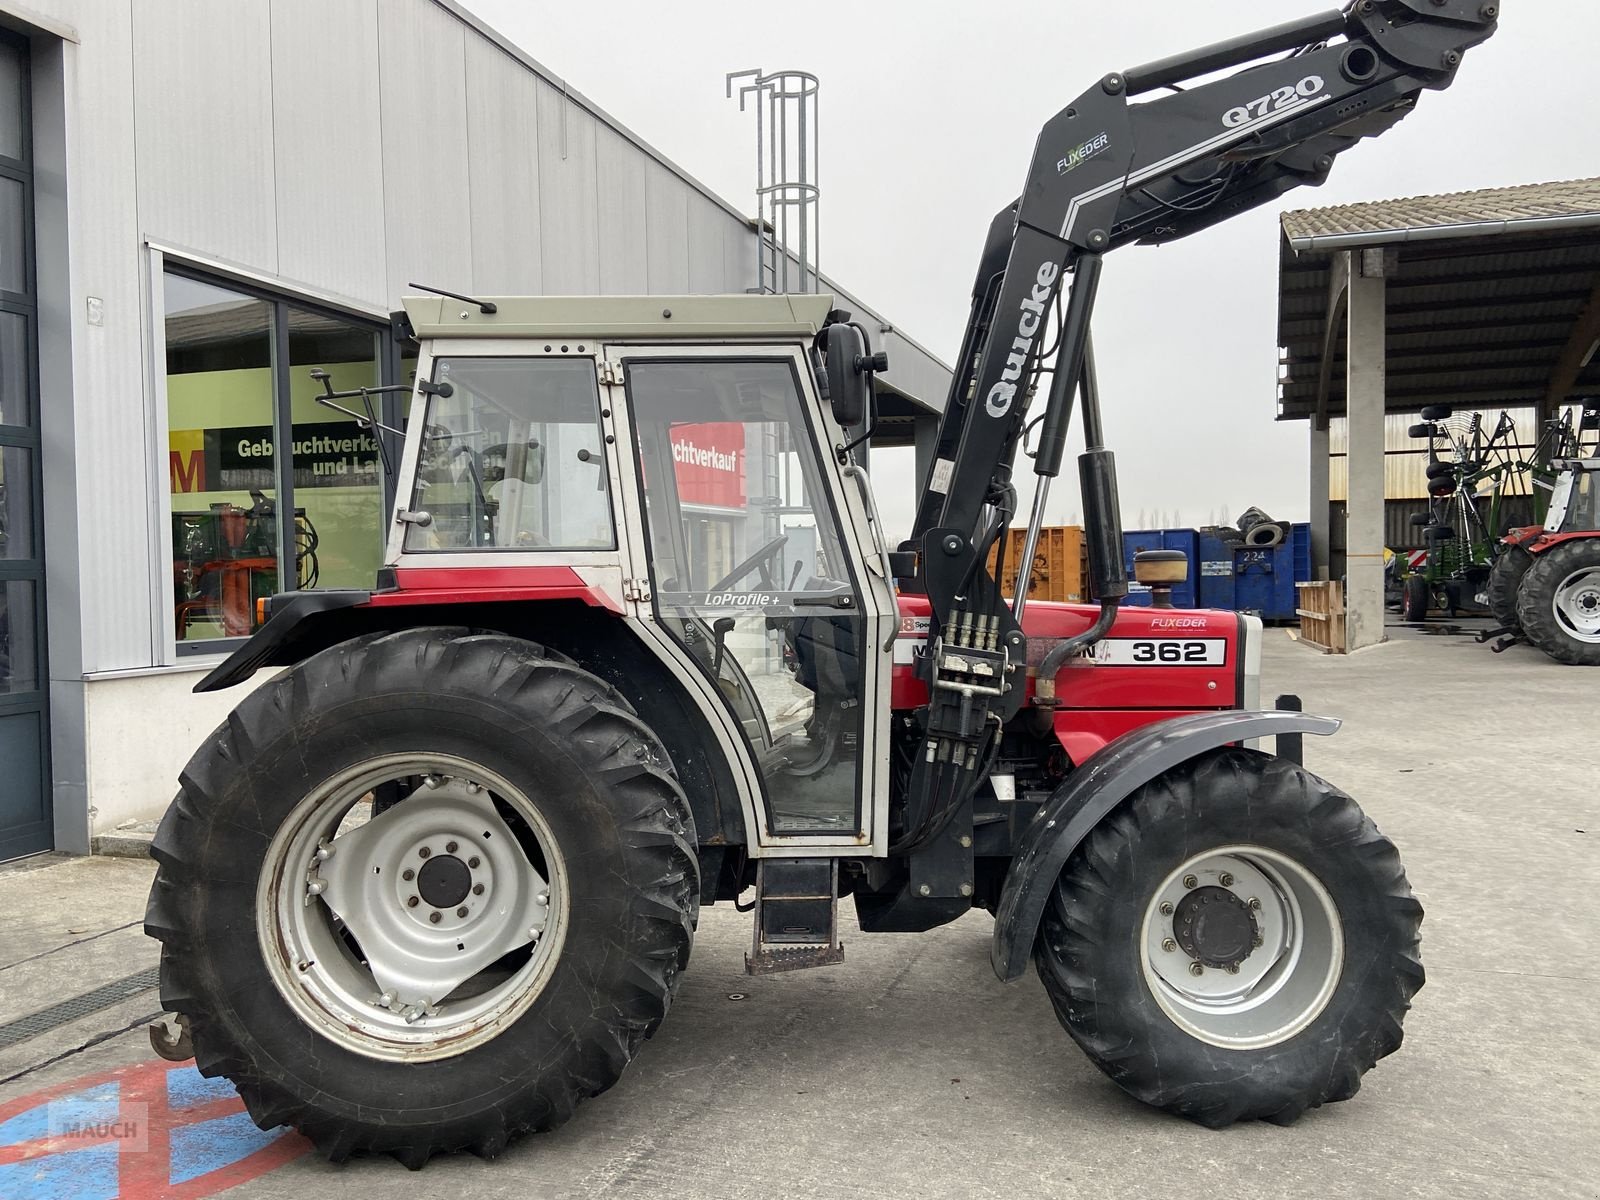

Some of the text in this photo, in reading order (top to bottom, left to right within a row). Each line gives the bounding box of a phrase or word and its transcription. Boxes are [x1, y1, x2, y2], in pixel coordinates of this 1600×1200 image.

[1221, 75, 1325, 128] Q720
[985, 261, 1059, 419] Quicke
[312, 456, 348, 476] und
[704, 592, 770, 606] LoProfile
[1132, 642, 1208, 662] 362
